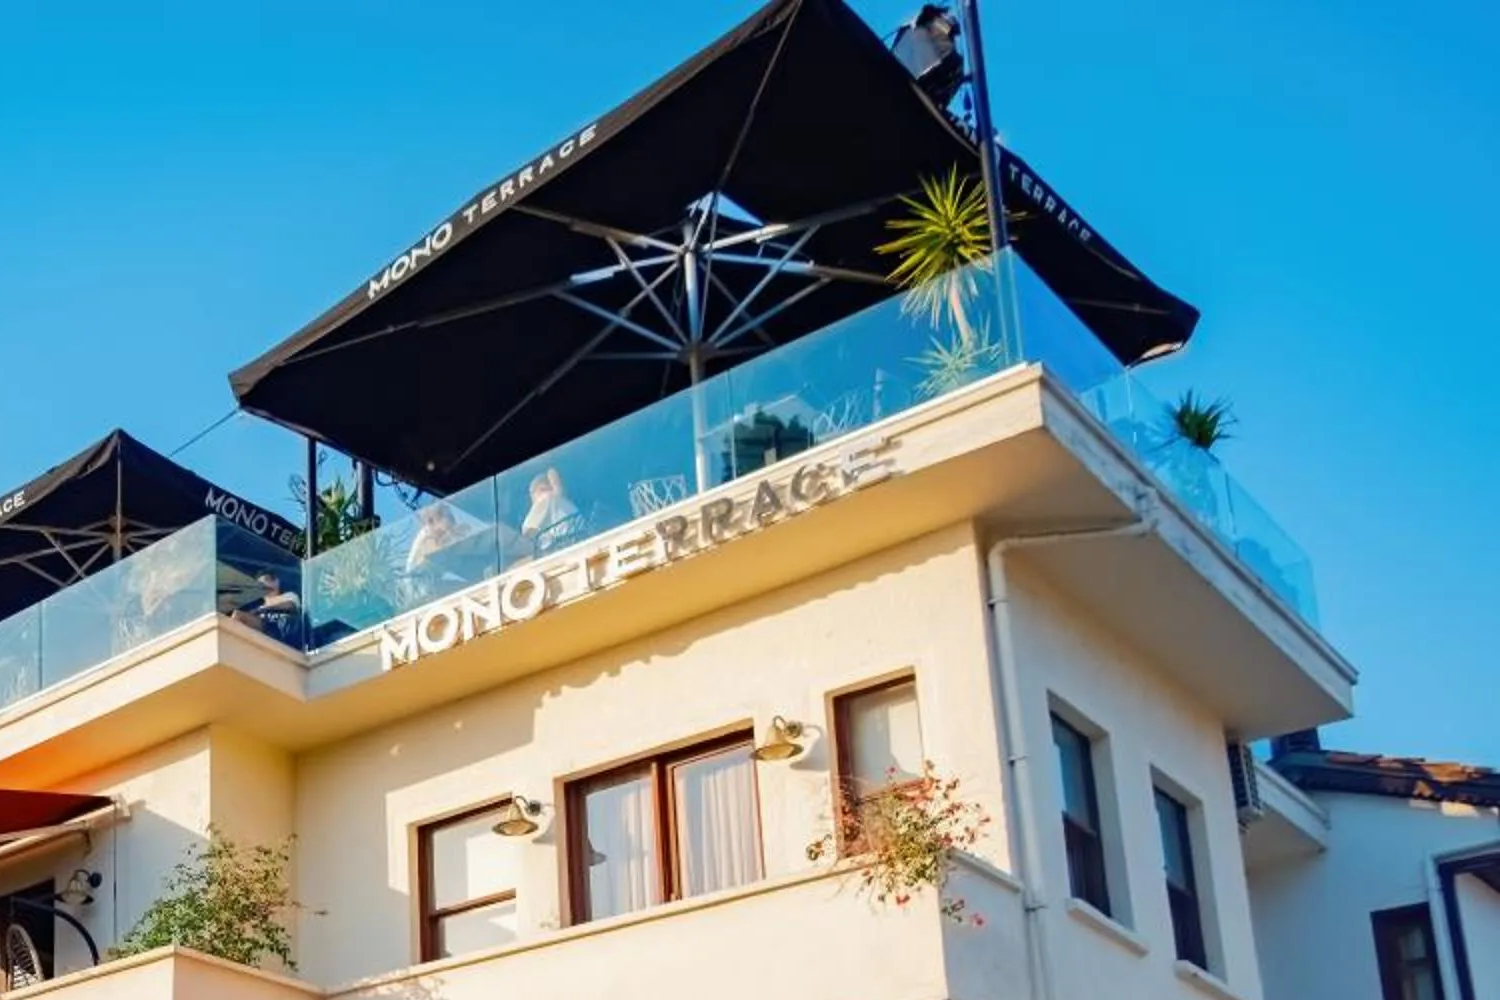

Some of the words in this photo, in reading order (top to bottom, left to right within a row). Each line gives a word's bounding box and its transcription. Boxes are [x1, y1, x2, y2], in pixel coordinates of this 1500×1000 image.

[367, 223, 453, 299] MONO
[462, 122, 598, 224] TERRACE
[205, 487, 269, 534] MONO
[380, 568, 546, 672] MONO
[560, 434, 902, 592] TERRACE
